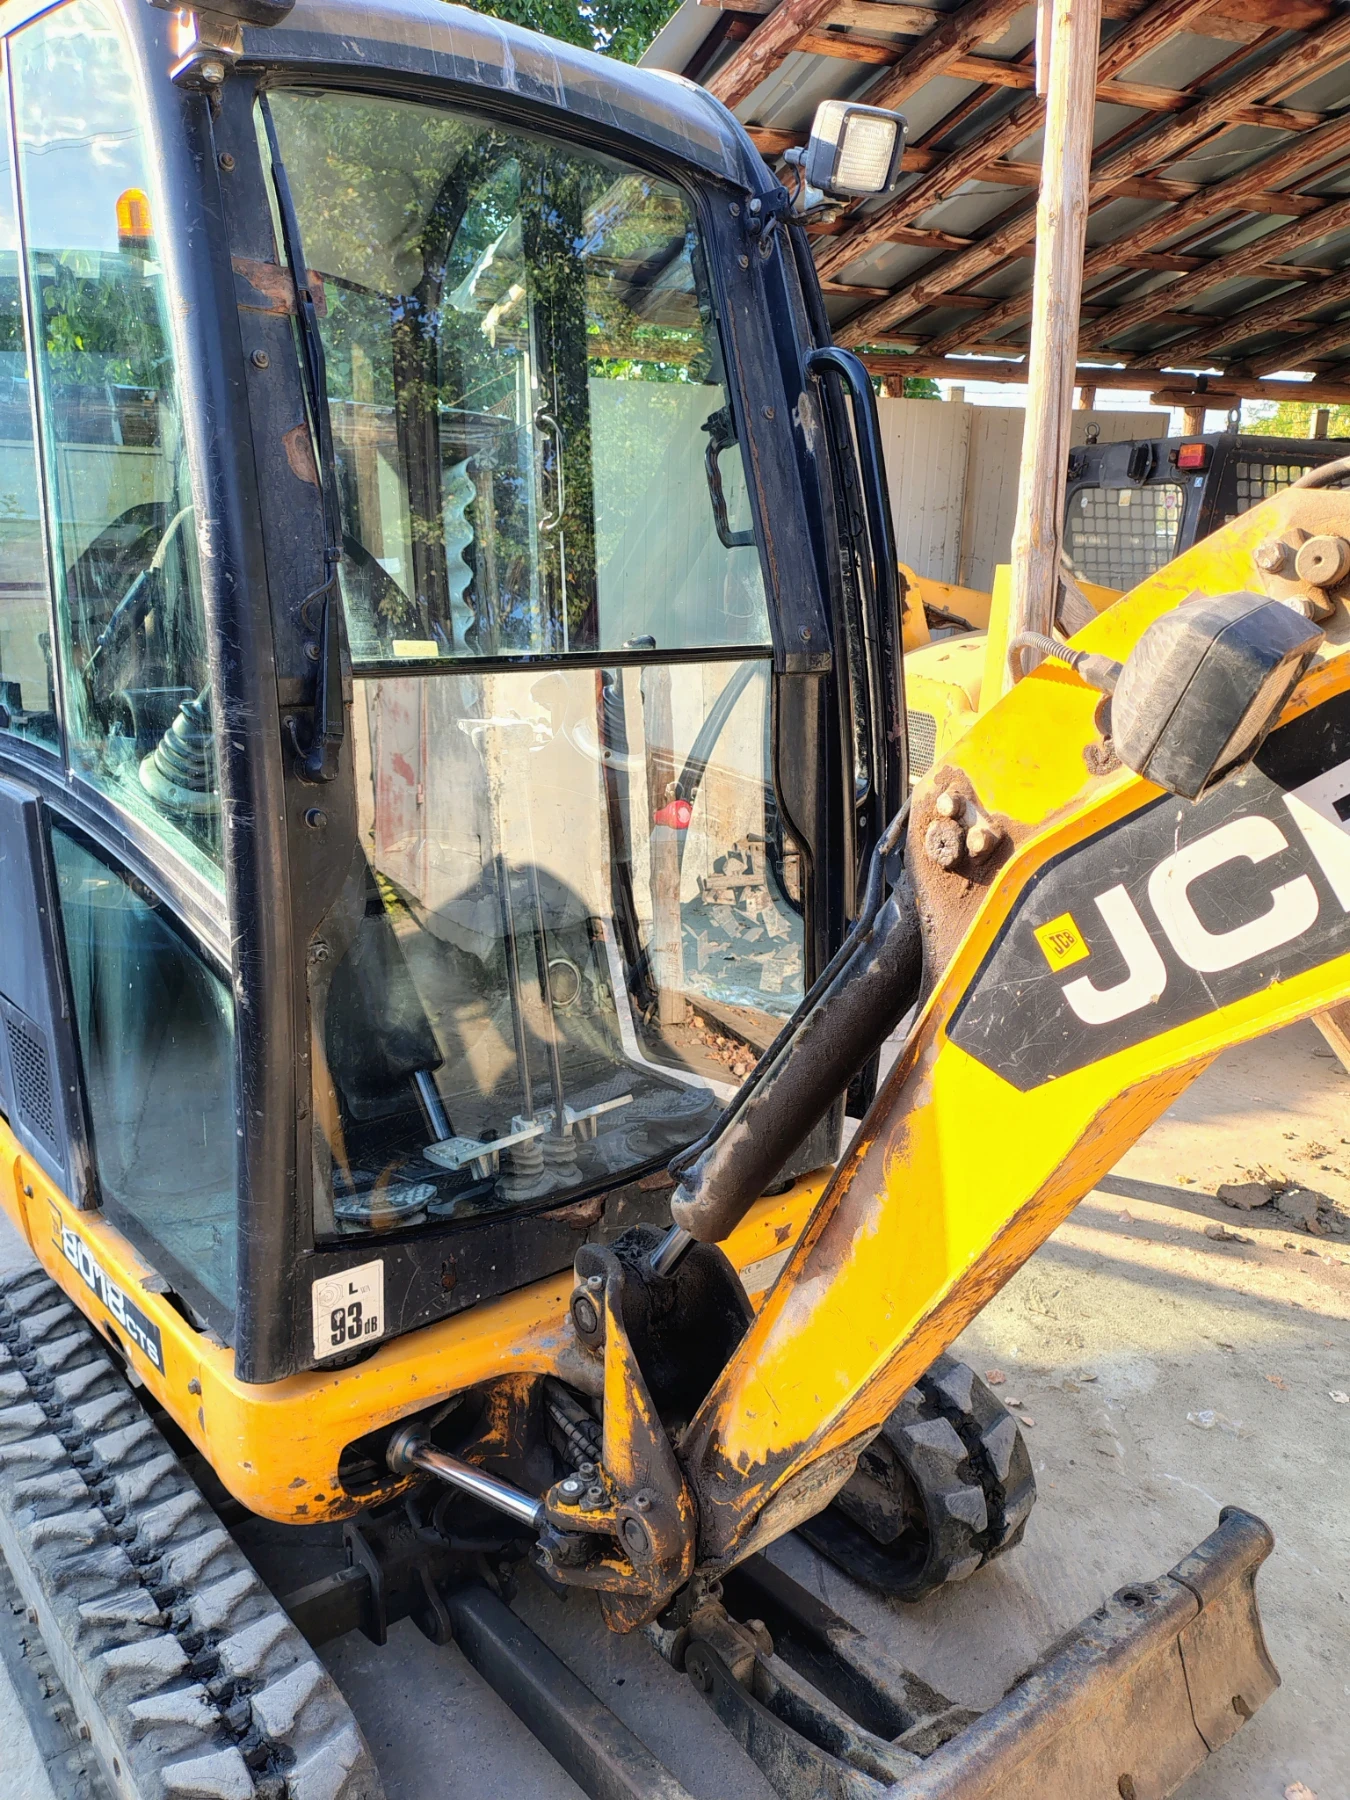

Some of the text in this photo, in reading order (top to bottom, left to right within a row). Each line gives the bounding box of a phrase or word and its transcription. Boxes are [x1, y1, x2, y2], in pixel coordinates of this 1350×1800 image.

[1049, 931, 1075, 955] JCB
[348, 1282, 359, 1295] L
[331, 1302, 378, 1346] 93 dB
